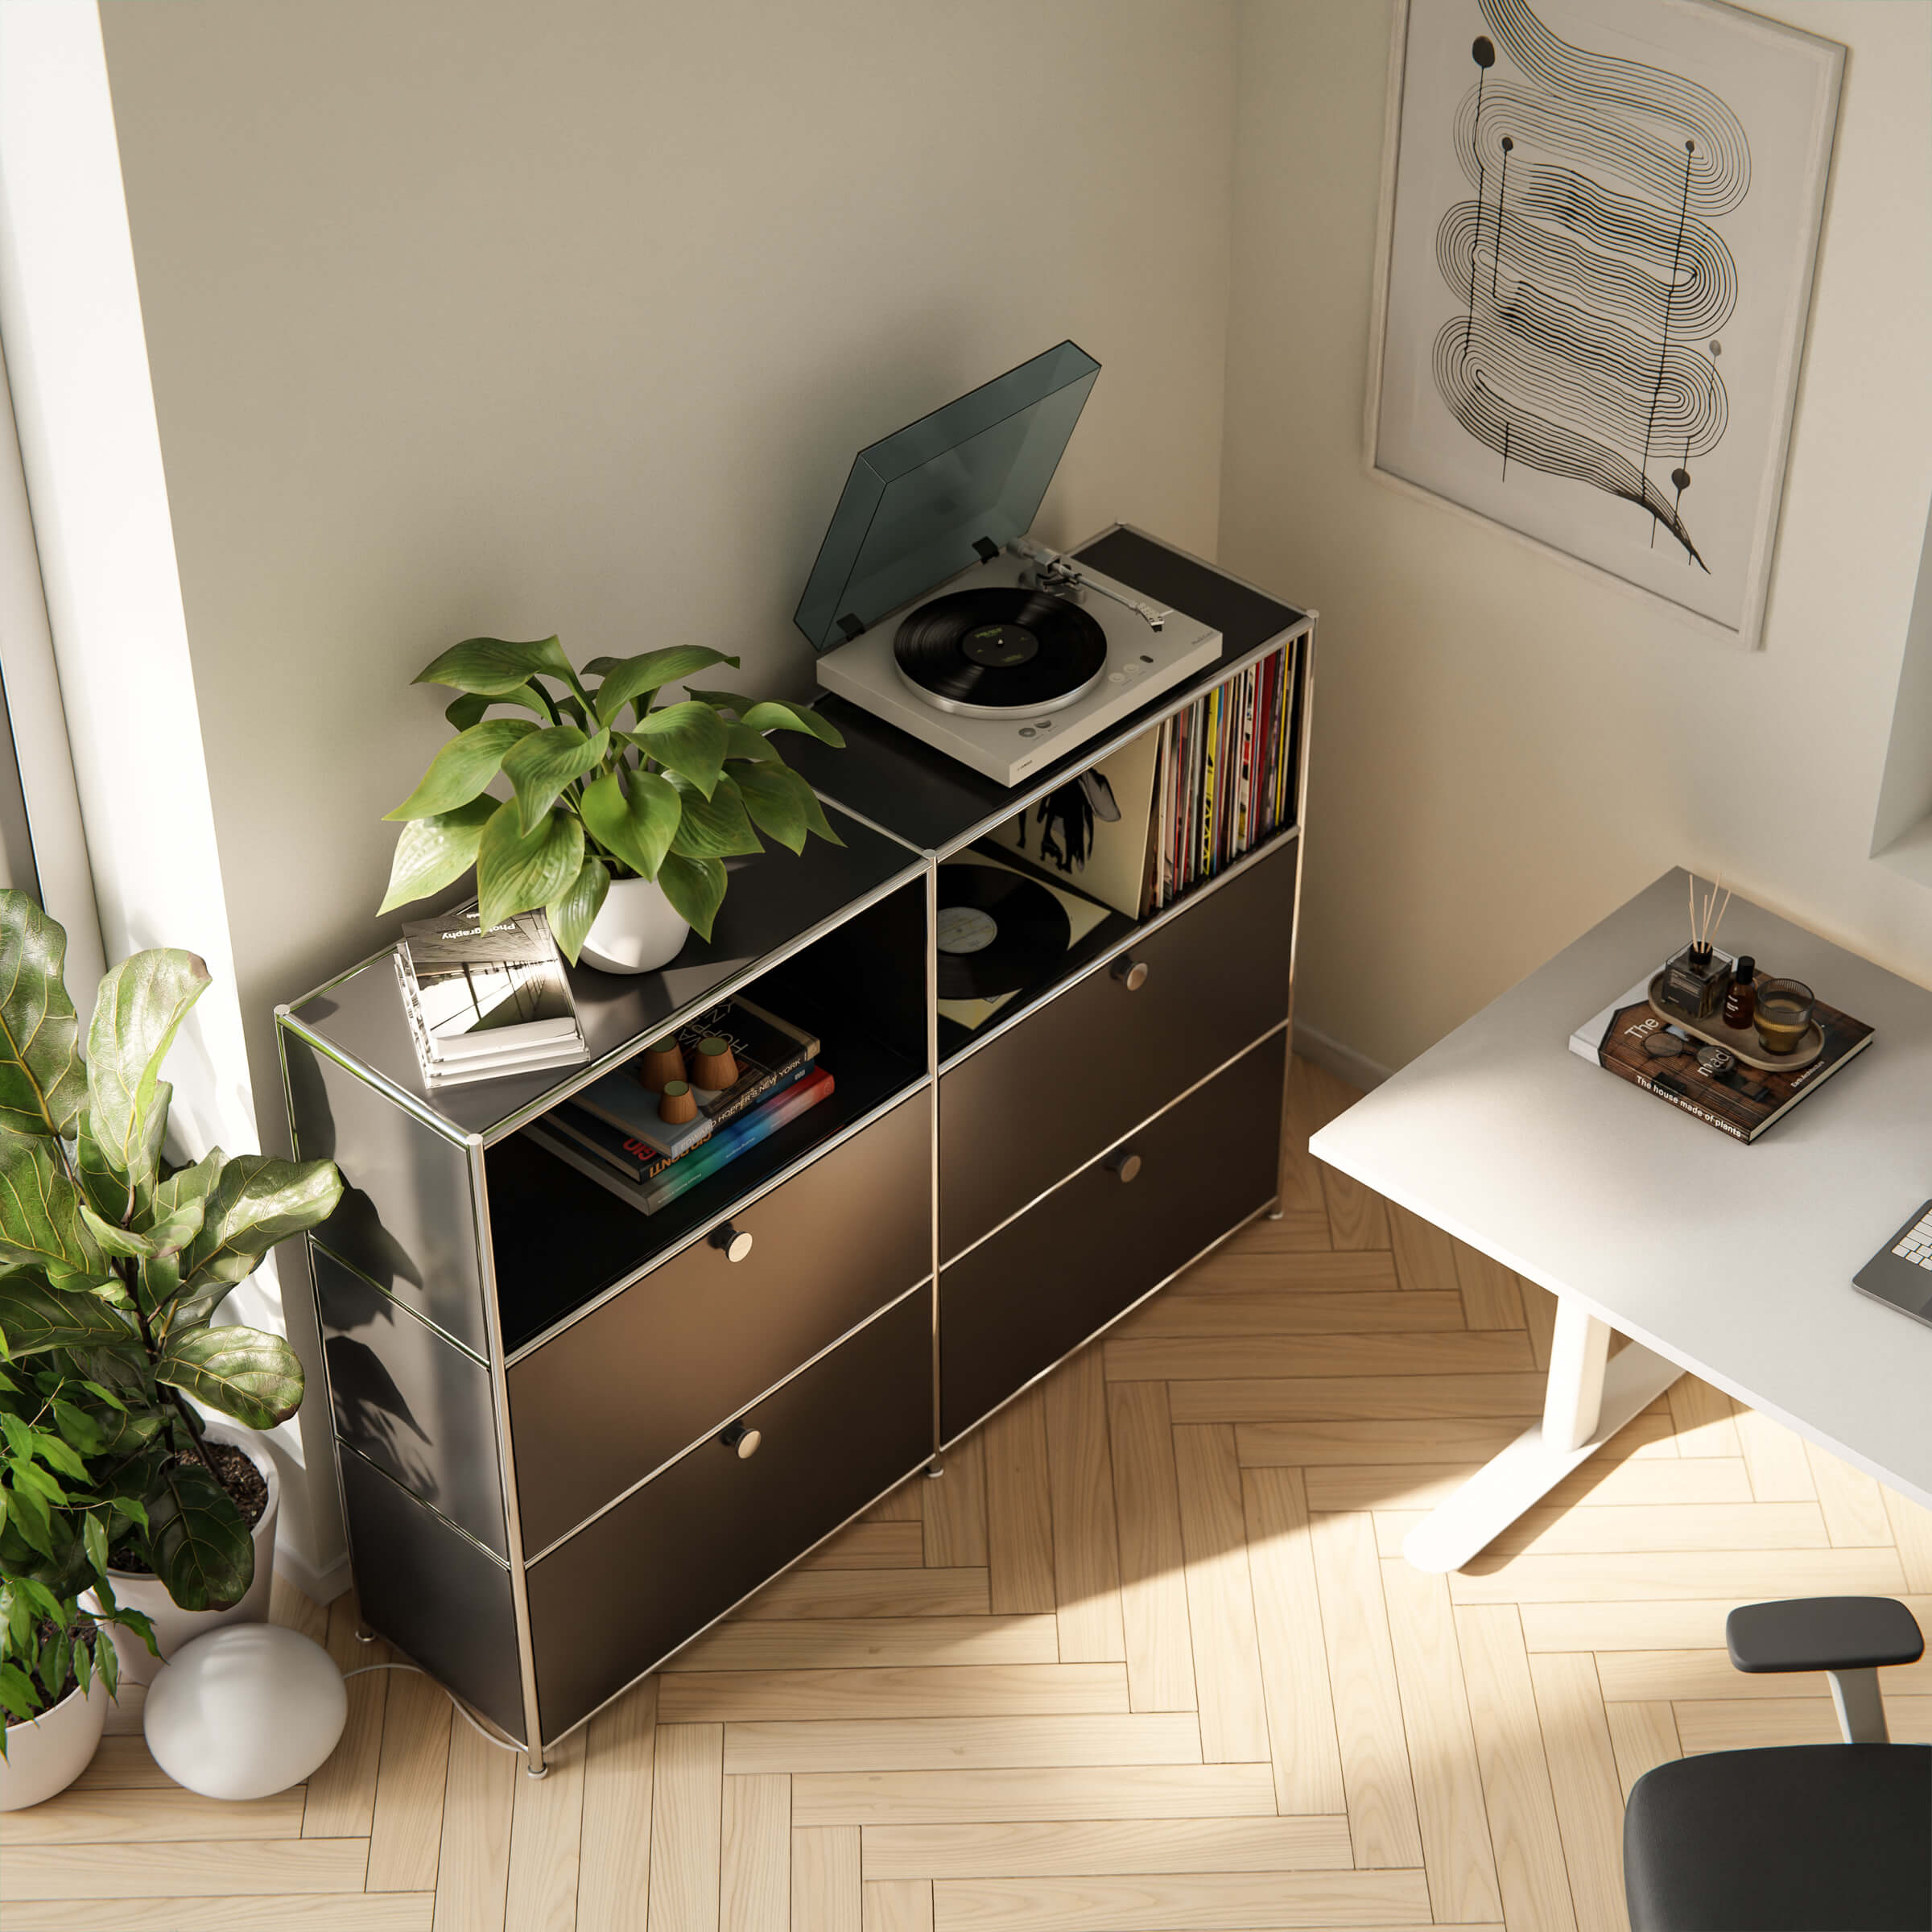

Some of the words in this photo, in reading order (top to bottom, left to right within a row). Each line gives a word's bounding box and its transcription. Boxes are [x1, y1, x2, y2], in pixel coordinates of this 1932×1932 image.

[442, 923, 515, 939] Photgraphy
[1624, 1018, 1659, 1038] The
[758, 1074, 778, 1094] NEW
[778, 1058, 801, 1077] YORK
[1697, 1050, 1731, 1076] mad
[1637, 1075, 1651, 1089] The
[1653, 1084, 1678, 1104] house
[1680, 1100, 1703, 1117] made
[1705, 1114, 1715, 1122] of
[1715, 1118, 1741, 1137] plants
